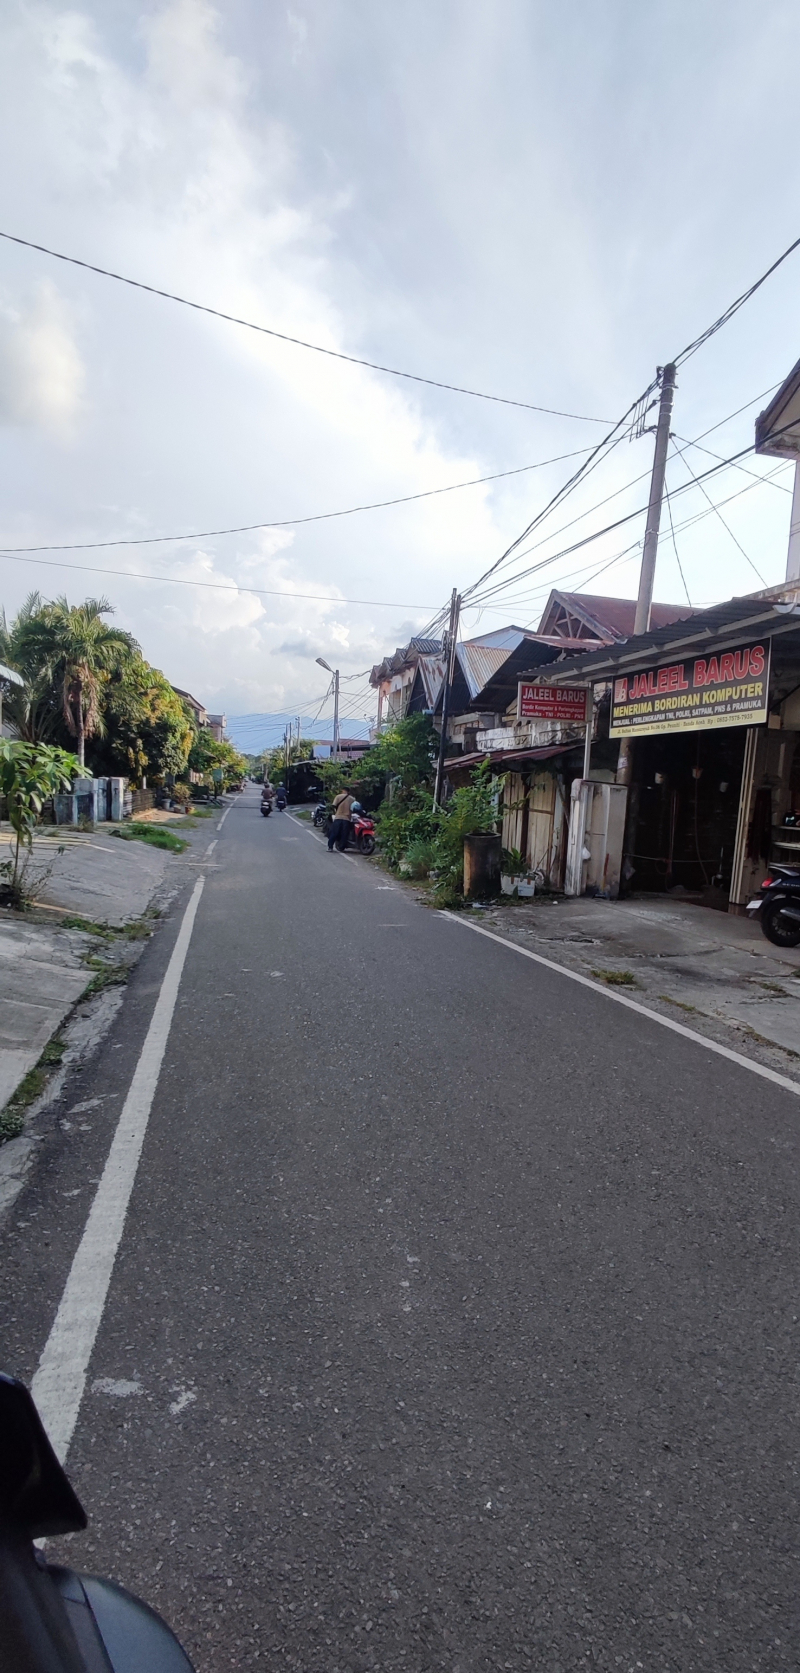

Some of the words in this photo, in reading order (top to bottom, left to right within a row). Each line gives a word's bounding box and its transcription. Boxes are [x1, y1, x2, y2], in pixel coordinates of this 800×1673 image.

[629, 664, 689, 700] JALEEL
[693, 645, 765, 687] BARUS
[523, 688, 554, 701] JALEEL
[556, 690, 585, 703] BARUS
[613, 701, 653, 718] MENERIMA
[654, 693, 700, 712] BORDIRAN
[702, 682, 763, 705] KOMPUTER
[632, 713, 665, 724] PERLENGKAPAN
[692, 705, 713, 716] SATPAM,
[714, 704, 726, 713] PNS
[726, 703, 731, 711] &
[732, 700, 762, 711] PRAMUKA
